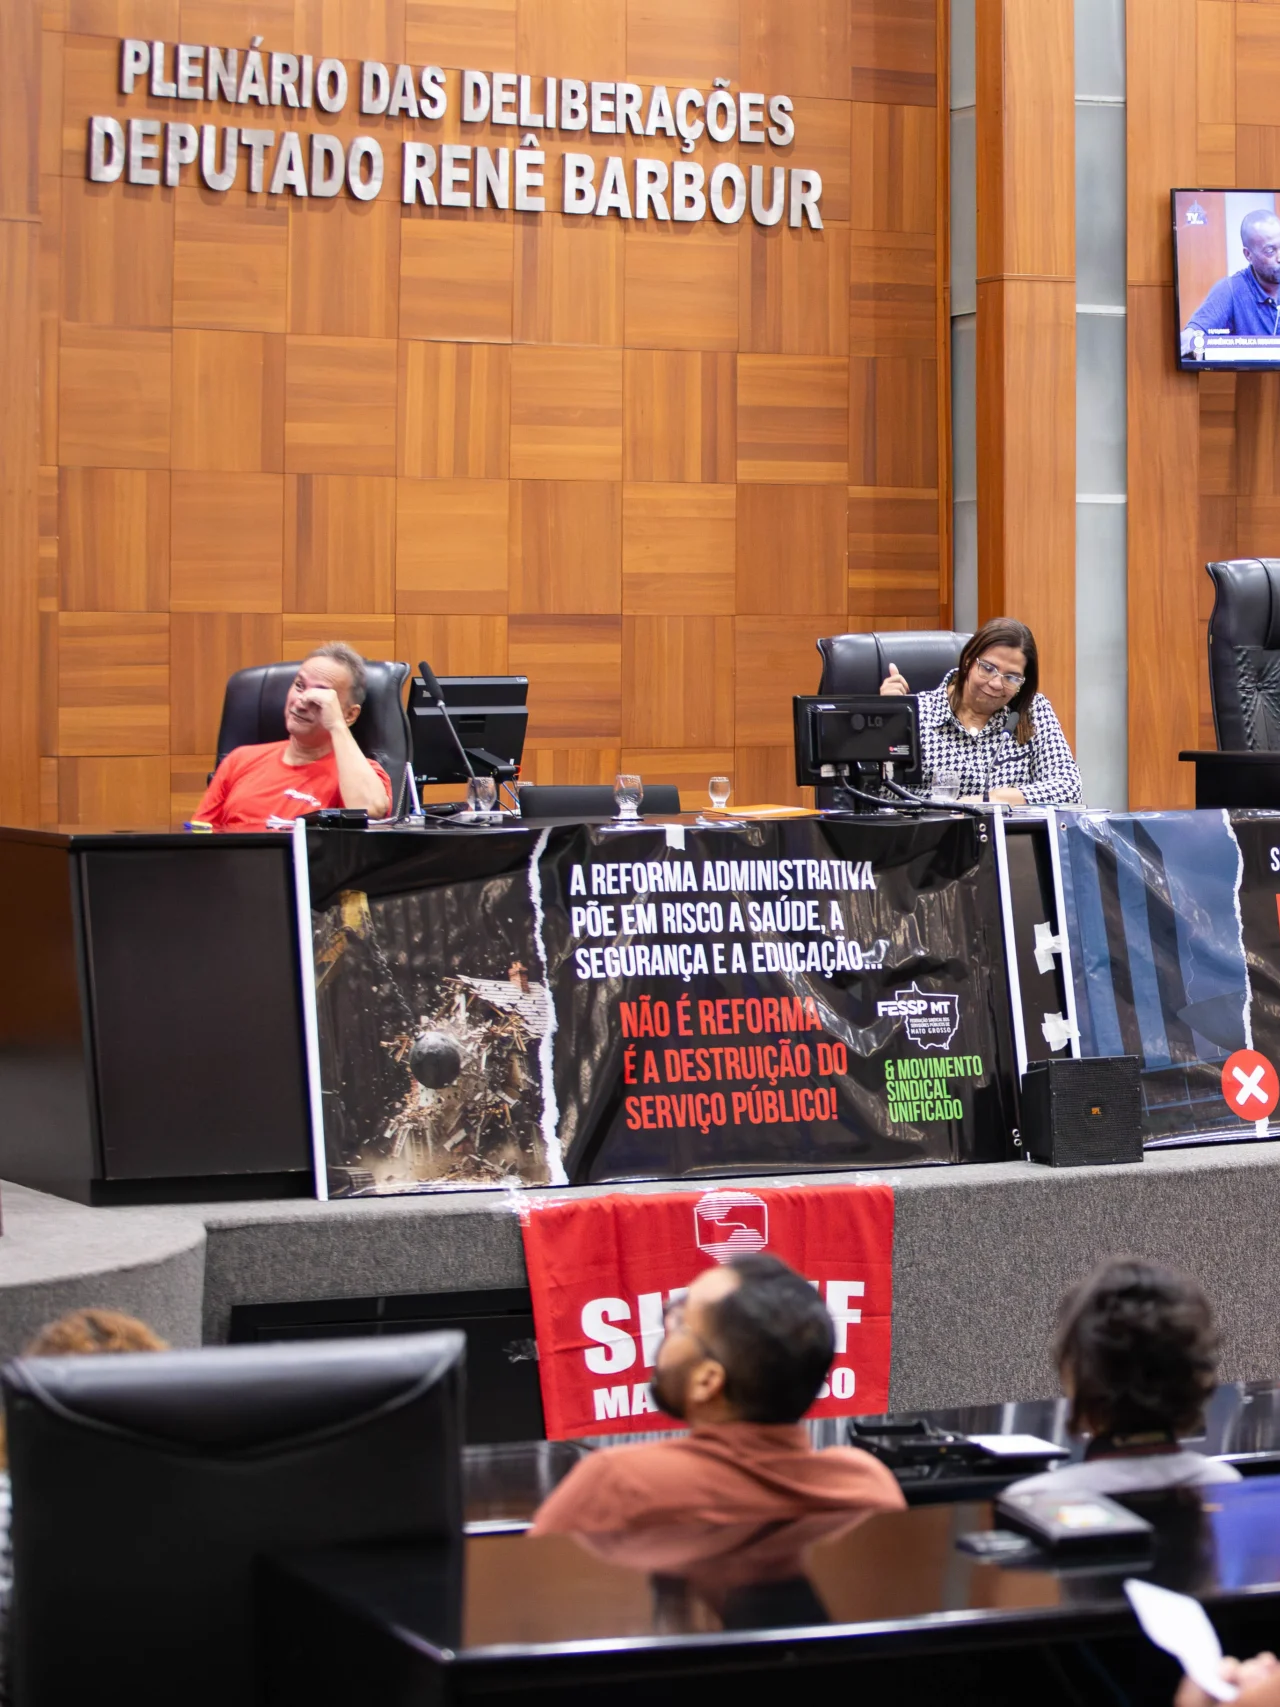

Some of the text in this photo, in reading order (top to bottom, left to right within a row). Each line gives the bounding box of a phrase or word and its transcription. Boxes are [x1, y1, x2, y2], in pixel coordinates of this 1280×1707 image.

[121, 36, 795, 153] PLENÁRIO DAS DELIBERAÇÕES
[88, 115, 824, 229] DEPUTADO RENÊ BARBOUR
[867, 716, 883, 727] LG
[570, 860, 876, 896] A REFORMA ADMINISTRATIVA
[571, 896, 844, 937] PÕE EM RISCO A SAÚDE, A
[576, 936, 883, 982] SEGURANÇA E A EDUCAÇÃO...
[620, 992, 822, 1038] NÃO É REFORMA
[877, 1000, 951, 1017] FESSP MT
[623, 1040, 848, 1086] É A DESTRUIÇÃO DO
[885, 1055, 983, 1081] & MOVIMENTO
[625, 1085, 838, 1134] SERVIÇO PÚBLICO!
[886, 1079, 951, 1102] SINDICAL
[889, 1099, 963, 1123] UNIFICADO
